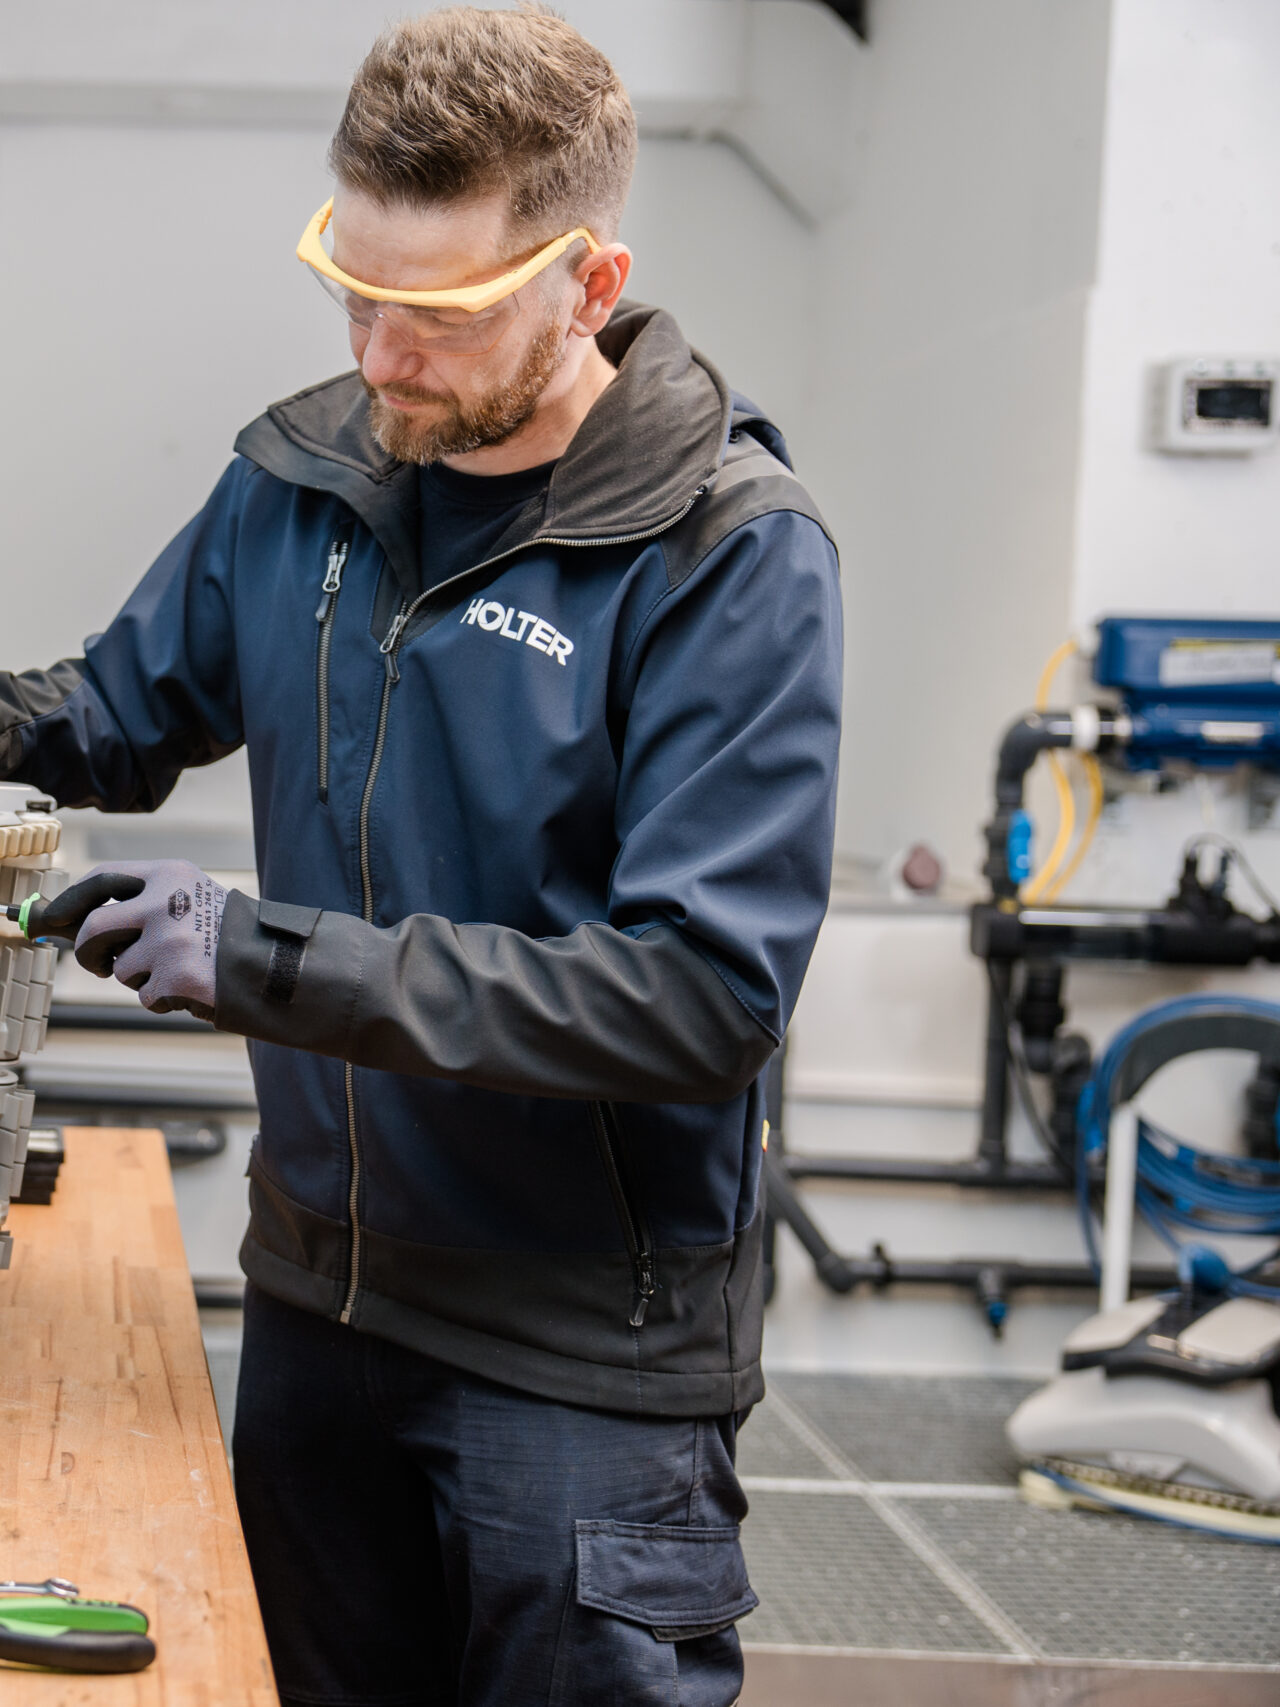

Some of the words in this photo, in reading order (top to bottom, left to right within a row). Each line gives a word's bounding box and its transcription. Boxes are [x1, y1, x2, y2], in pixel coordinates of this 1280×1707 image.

[460, 598, 575, 666] HOLTER
[195, 882, 203, 907] GRIP
[195, 912, 203, 932] NIT
